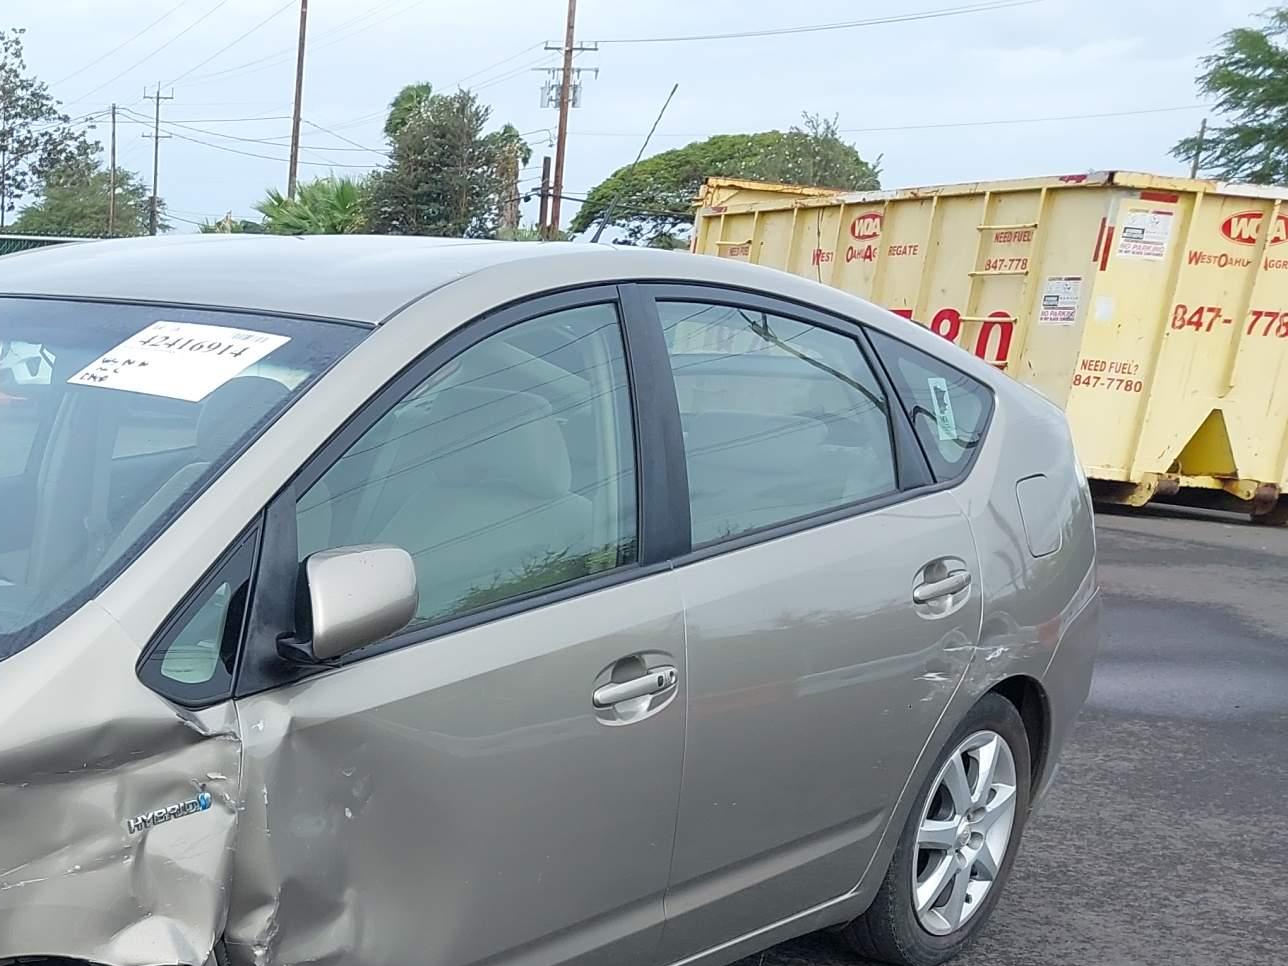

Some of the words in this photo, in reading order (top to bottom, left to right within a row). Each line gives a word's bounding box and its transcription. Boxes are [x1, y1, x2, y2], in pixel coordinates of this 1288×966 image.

[994, 231, 1012, 243] NEED
[139, 334, 250, 359] 42416914
[1080, 359, 1107, 372] NEED
[1108, 361, 1140, 375] FUEL?
[1073, 374, 1143, 393] 847-7780
[127, 799, 202, 834] HYBRID
